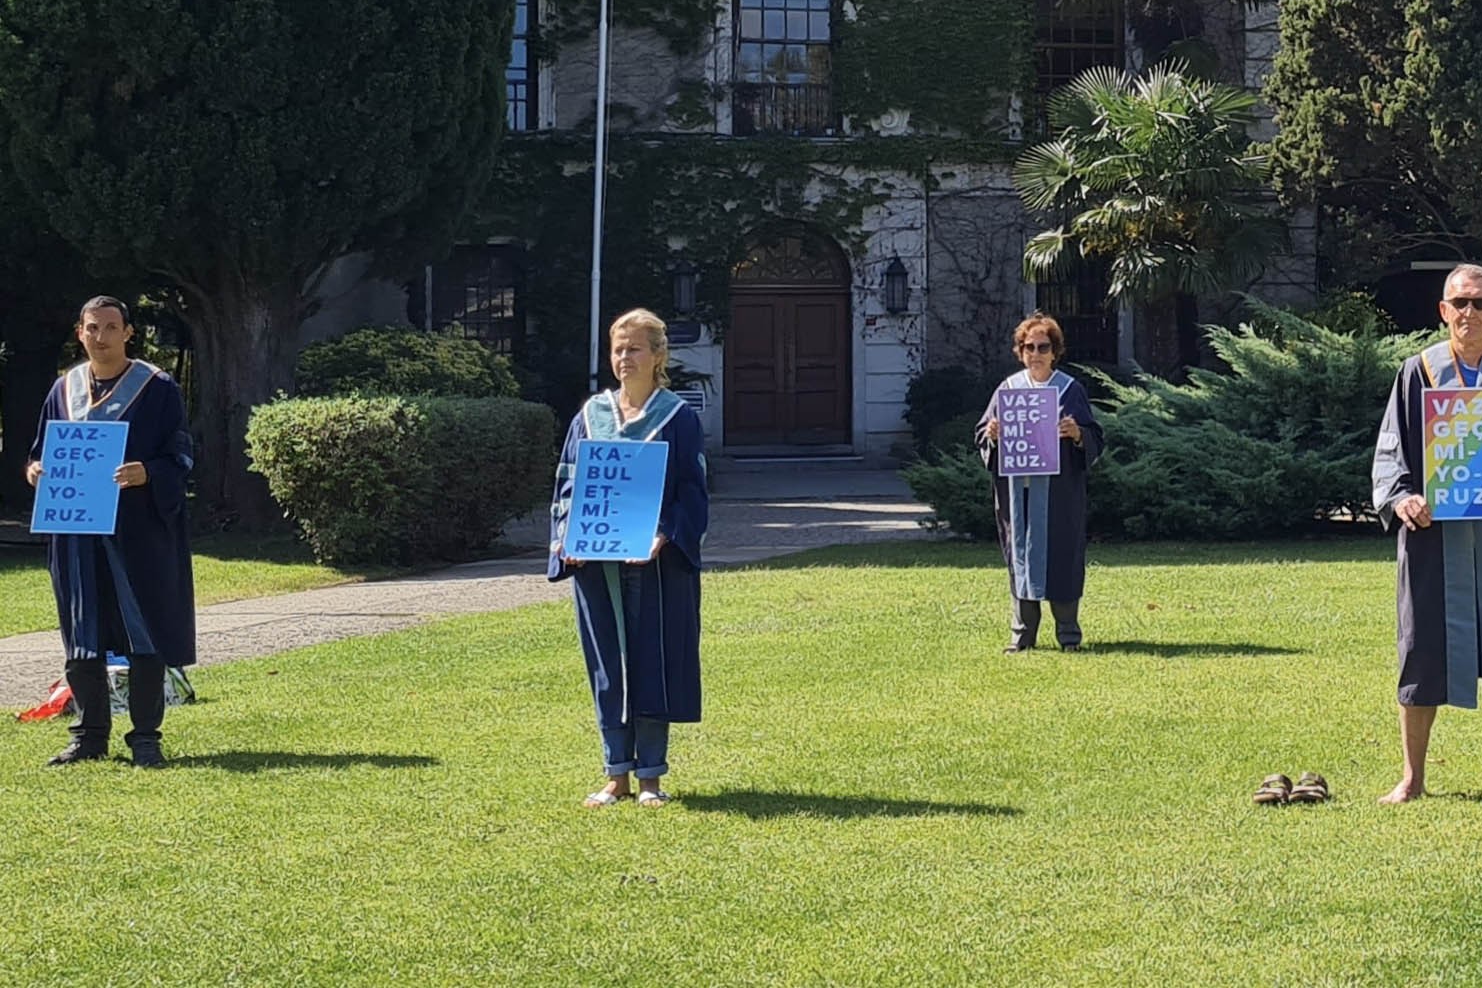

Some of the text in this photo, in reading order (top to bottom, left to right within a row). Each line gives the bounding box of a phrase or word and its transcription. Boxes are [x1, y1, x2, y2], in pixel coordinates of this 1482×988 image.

[1002, 393, 1047, 407] VAZ-
[1003, 409, 1048, 423] GEÇ-
[56, 427, 108, 440] VAZ-
[589, 446, 632, 461] KA-
[1004, 440, 1036, 453] YO-
[53, 447, 105, 463] GEÇ-
[1004, 455, 1047, 468] RUZ.
[586, 466, 632, 481] BUL
[1435, 465, 1482, 482] YO-
[48, 486, 85, 499] YO-
[584, 485, 621, 499] ET-
[44, 508, 94, 522] RUZ.
[580, 522, 620, 535] YO-
[574, 540, 628, 553] RUZ.
